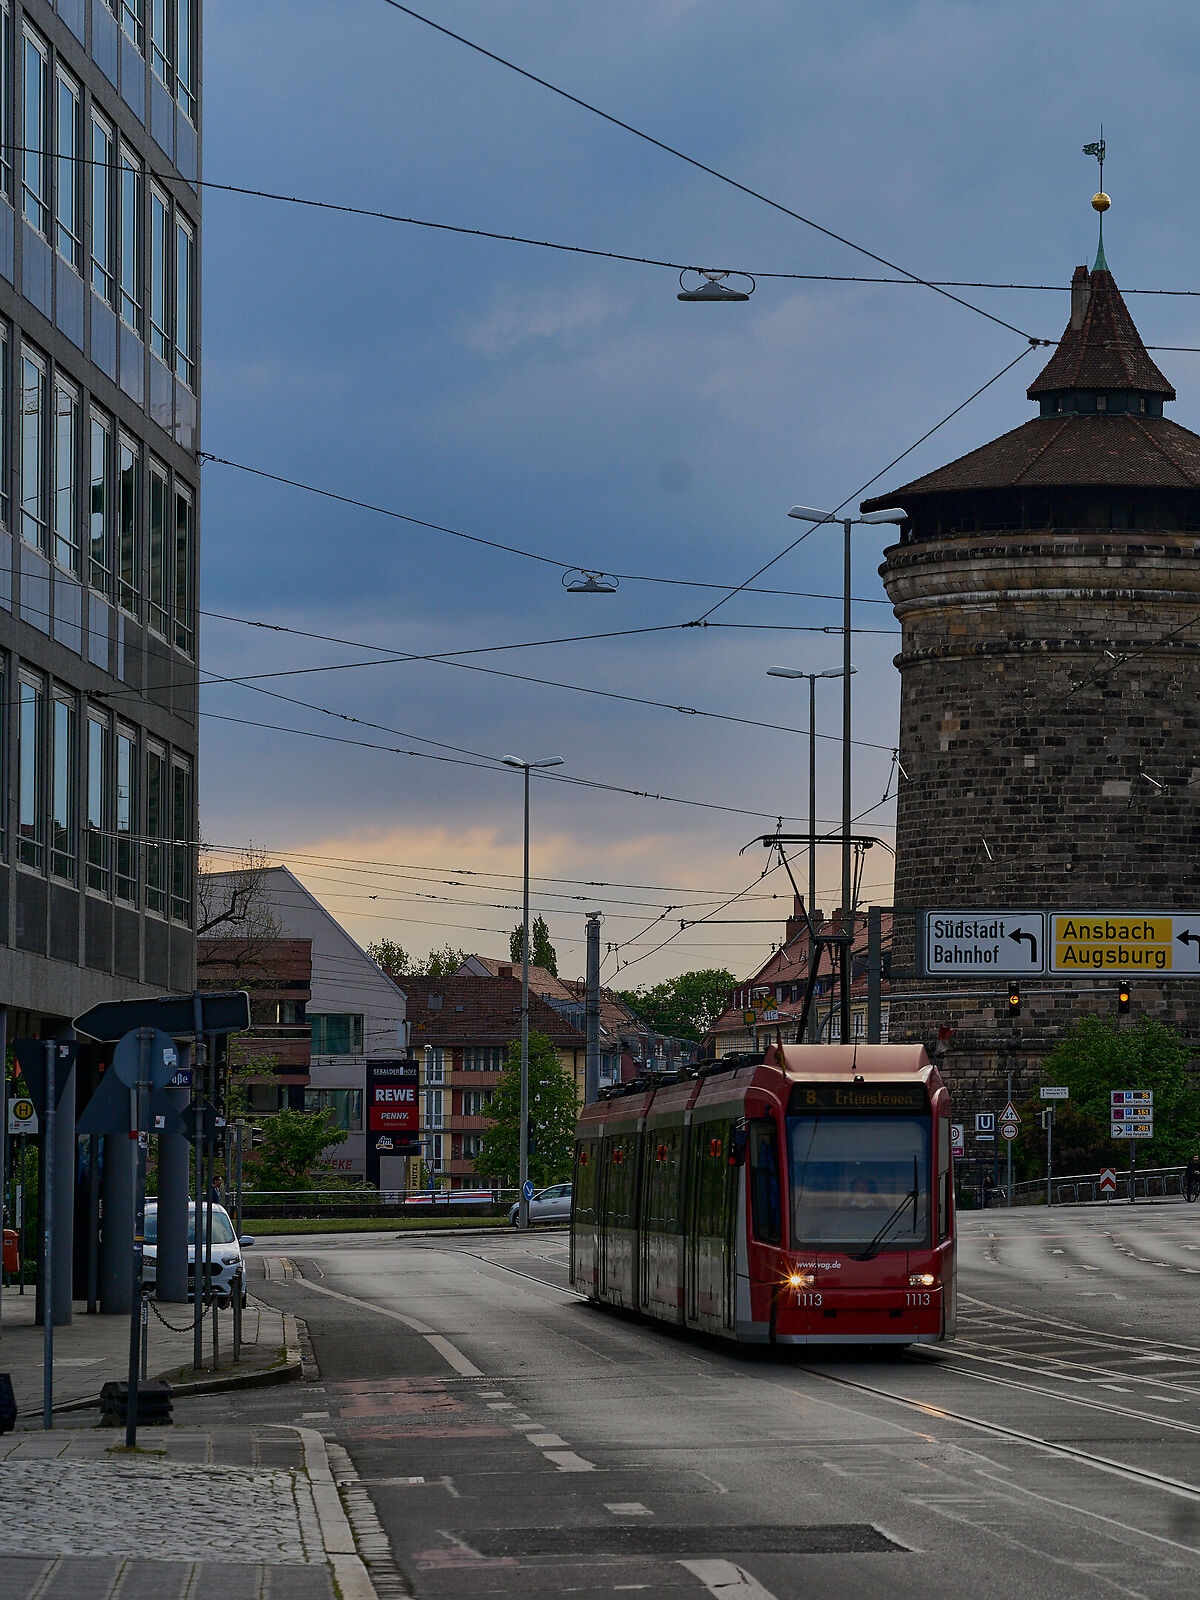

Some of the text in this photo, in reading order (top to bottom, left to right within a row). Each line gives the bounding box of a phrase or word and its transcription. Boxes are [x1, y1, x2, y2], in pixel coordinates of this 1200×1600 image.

[934, 920, 1005, 939] Südstadt
[1062, 921, 1155, 940] Ansbach
[934, 945, 1000, 964] Bahnhof
[1062, 946, 1167, 968] Augsburg
[375, 1089, 415, 1102] REWE
[806, 1090, 816, 1104] 8
[980, 1116, 991, 1129] U
[796, 1261, 841, 1271] www.vag.de
[796, 1293, 823, 1306] 1113
[905, 1293, 931, 1306] 1113
